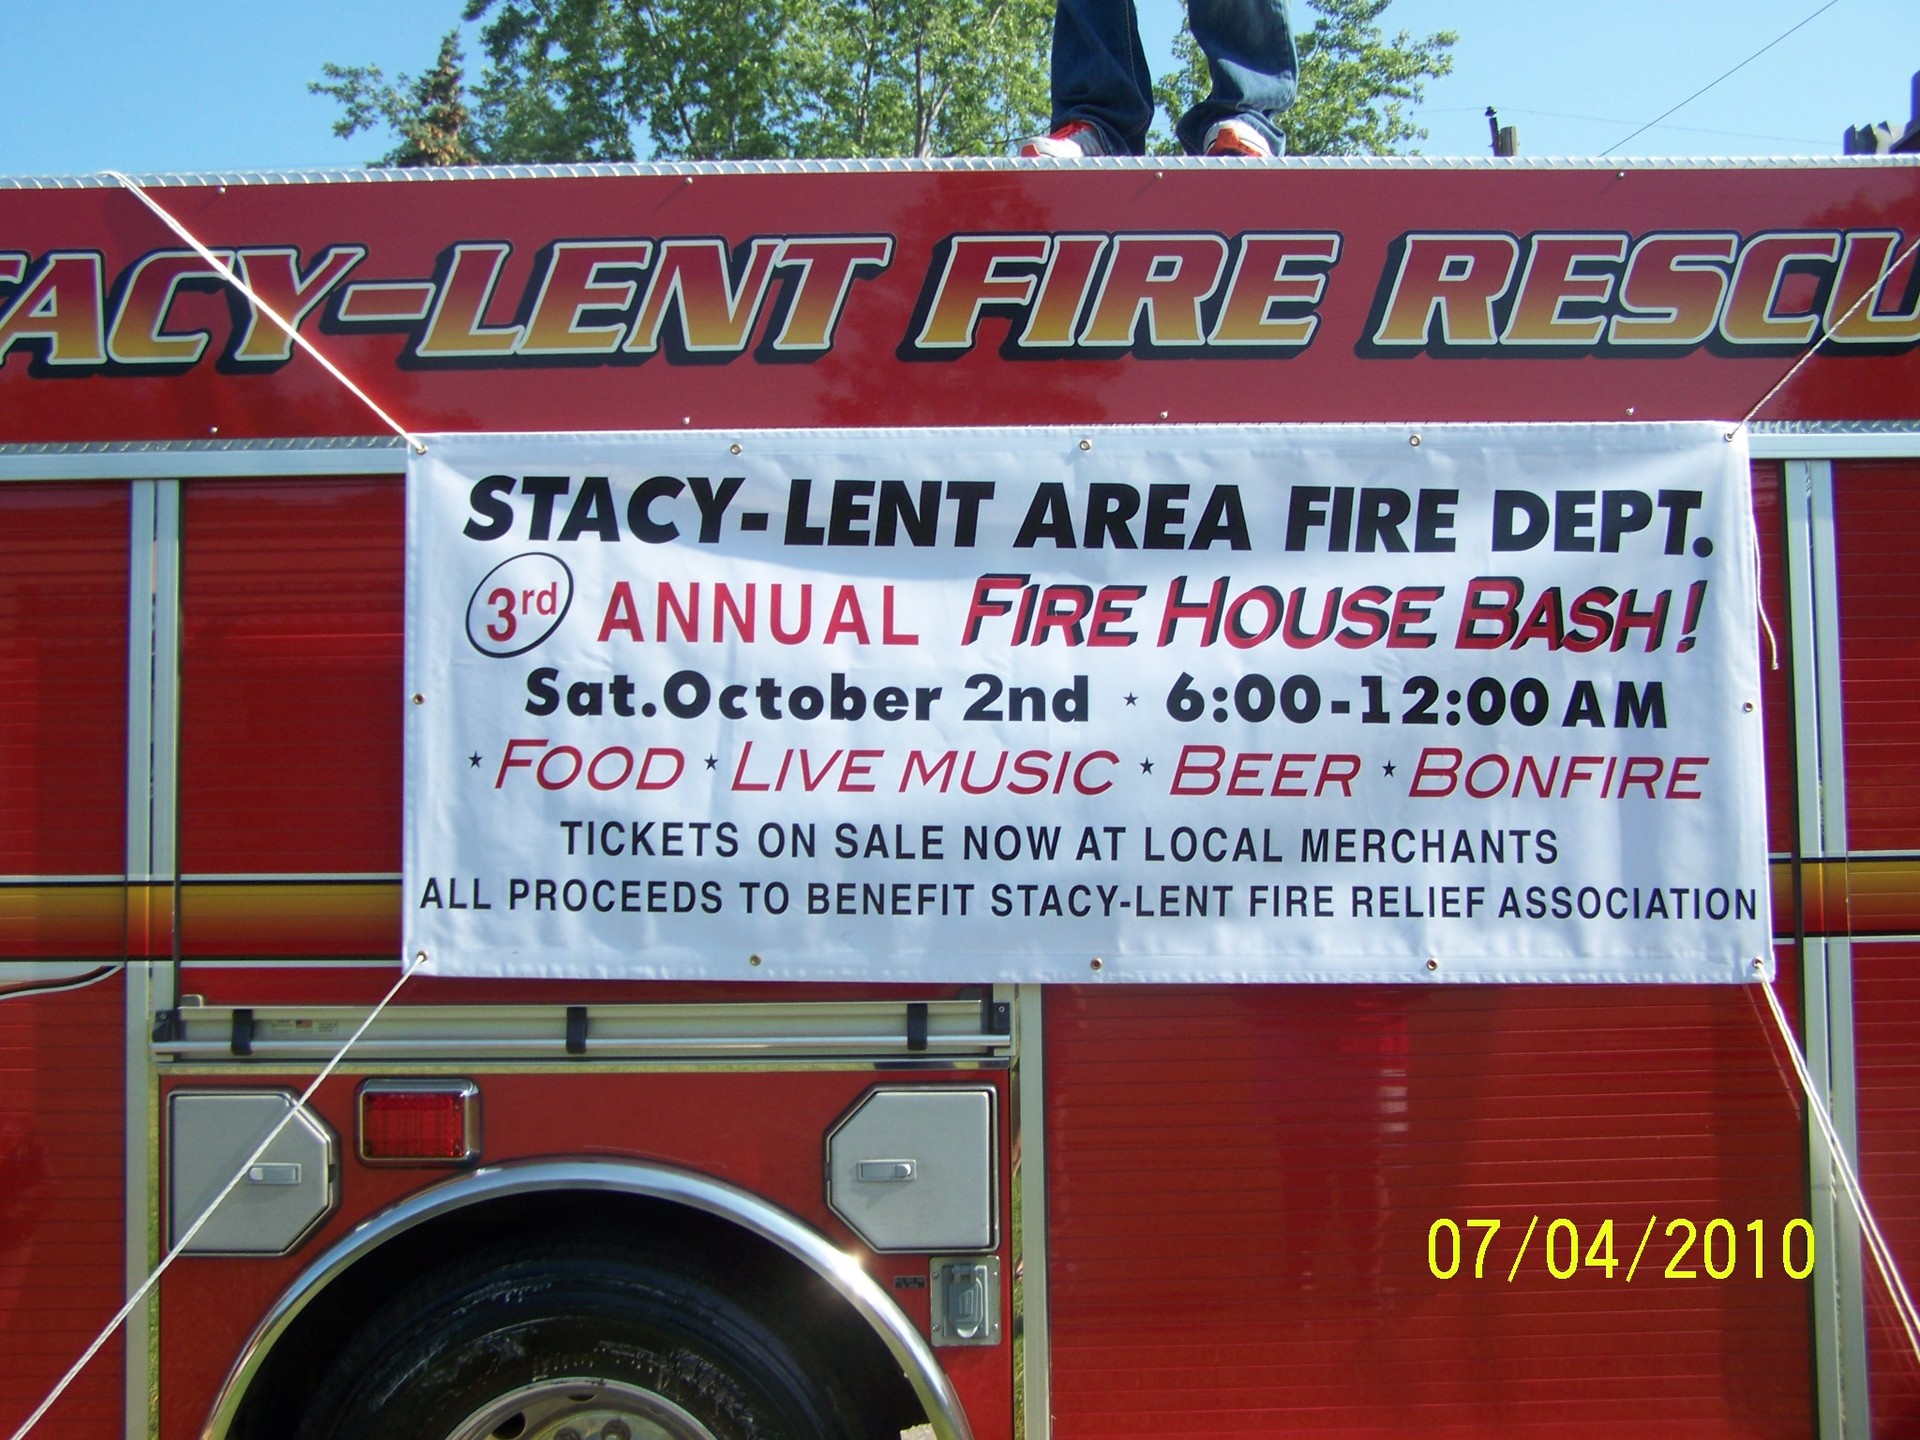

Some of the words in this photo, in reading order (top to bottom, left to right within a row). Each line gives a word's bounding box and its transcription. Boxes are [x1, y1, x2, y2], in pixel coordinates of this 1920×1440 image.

[0, 234, 897, 372] ACY-LENT
[902, 233, 1344, 354] FIRE
[463, 475, 995, 547] STACY-LENT
[1013, 482, 1252, 550] AREA
[1285, 486, 1459, 552] FIRE
[1492, 490, 1713, 558] DEPT.
[487, 582, 556, 641] 3rd
[598, 582, 918, 645] ANNUAL
[961, 573, 1147, 647] FIRE
[1157, 576, 1445, 649] HOUSE
[1455, 576, 1708, 652] BASH!
[963, 674, 1088, 722] 2nd
[1166, 672, 1549, 726] 6:00-12:00
[1562, 681, 1667, 728] AM
[495, 739, 684, 790] FOOD
[731, 741, 884, 792] LIVE
[899, 750, 1119, 795] MUSIC
[1170, 745, 1360, 796] BEER
[1409, 748, 1709, 799] BONFIRE
[560, 821, 738, 857] TICKETS
[759, 822, 815, 858] ON
[835, 823, 943, 859] SALE
[964, 825, 1061, 860] NOW
[1076, 827, 1126, 861] AT
[1145, 826, 1282, 862] LOCAL
[1301, 829, 1557, 864] MERCHANTS
[420, 878, 491, 909] ALL
[510, 879, 722, 913] PROCEEDS
[739, 882, 789, 914] TO
[808, 883, 974, 915] BENEFIT
[991, 884, 1233, 917] STACY-LENT
[1250, 886, 1333, 917] FIRE
[1353, 886, 1485, 918] RELIEF
[1498, 886, 1755, 920] ASSOCIATION
